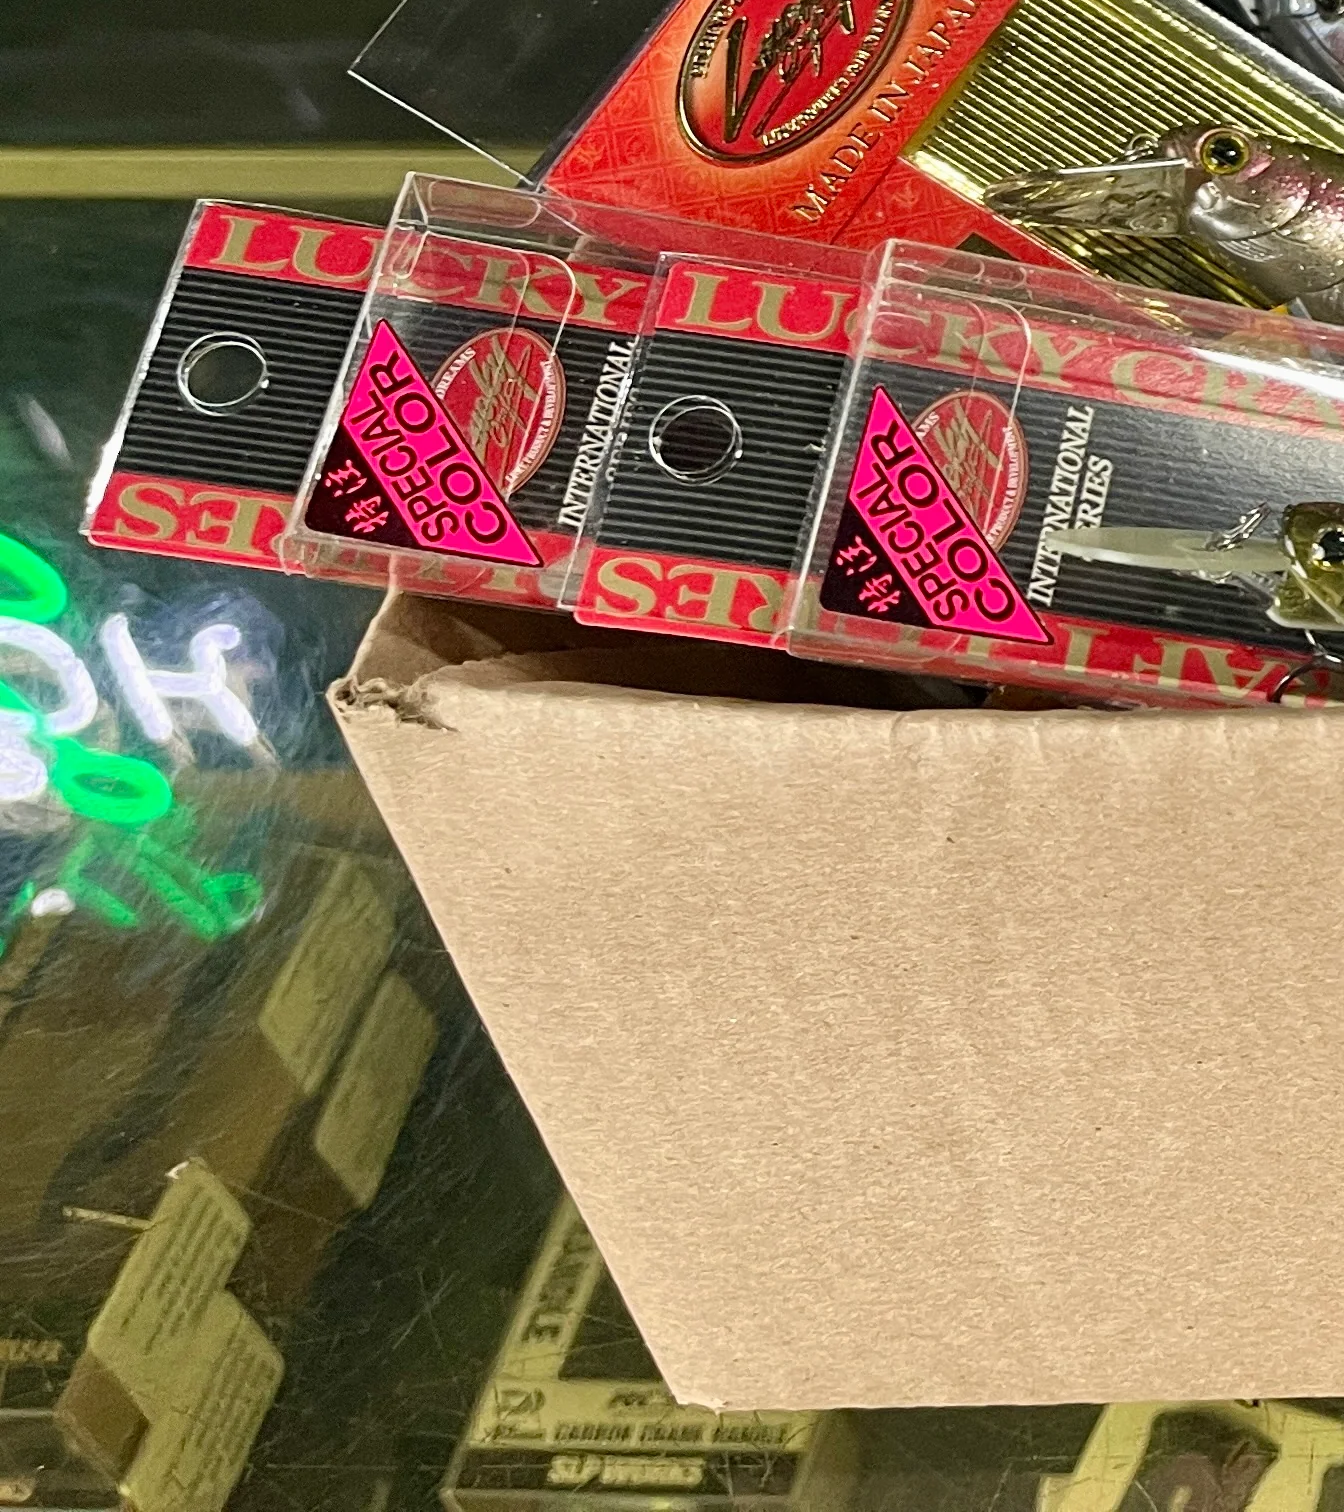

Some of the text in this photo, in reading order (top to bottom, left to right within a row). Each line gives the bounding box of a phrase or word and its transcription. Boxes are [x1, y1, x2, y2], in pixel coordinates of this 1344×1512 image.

[791, 121, 885, 224] MADE
[868, 79, 914, 124] IN
[214, 213, 648, 330] LUCKY
[676, 269, 1100, 389] LUCKY
[324, 458, 390, 534] 特注
[350, 389, 461, 544] SPECIAL
[369, 349, 508, 544] COLOR
[557, 340, 637, 529] INTERNATIONAL
[835, 534, 901, 614] 特注
[855, 461, 971, 622] SPECIAL
[870, 418, 1017, 623] COLOR
